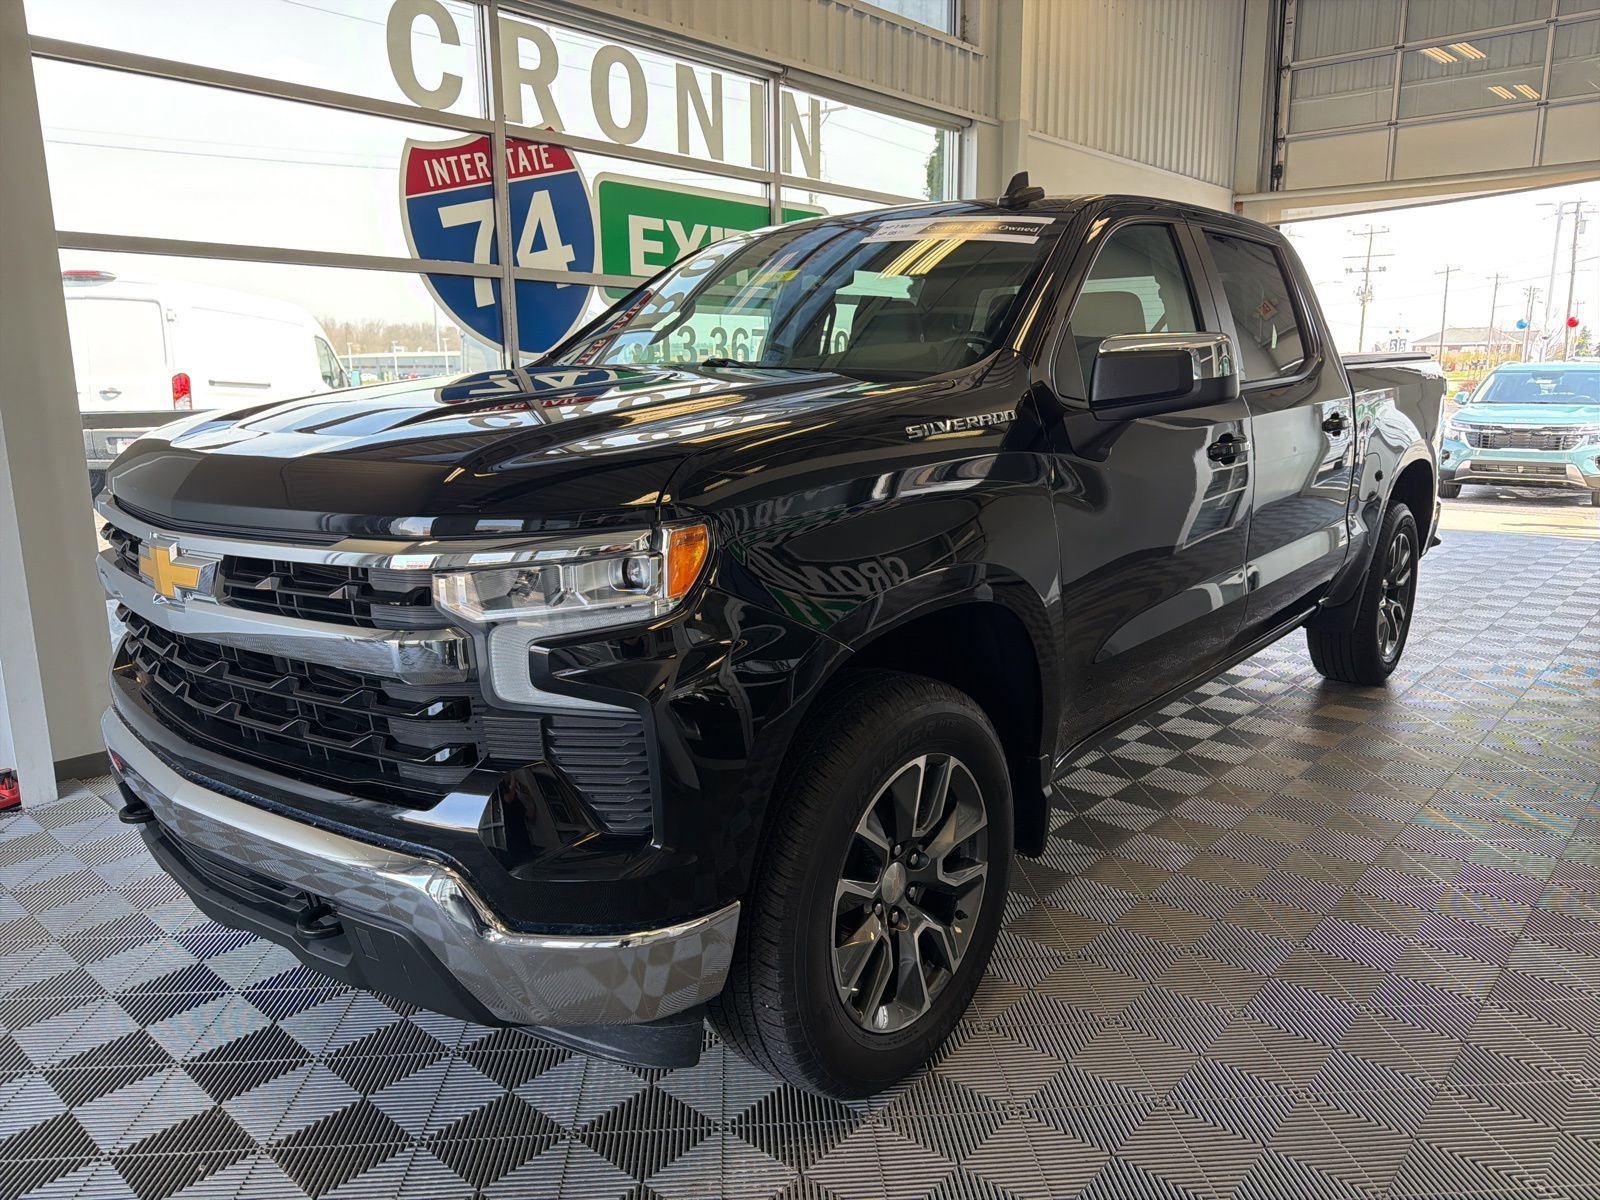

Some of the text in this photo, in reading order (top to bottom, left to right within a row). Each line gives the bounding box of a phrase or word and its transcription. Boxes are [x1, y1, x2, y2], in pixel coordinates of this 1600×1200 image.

[387, 0, 821, 179] CRONIN
[423, 144, 555, 188] INTERTATE
[437, 189, 576, 308] 74
[905, 409, 1018, 439] SILVERADO
